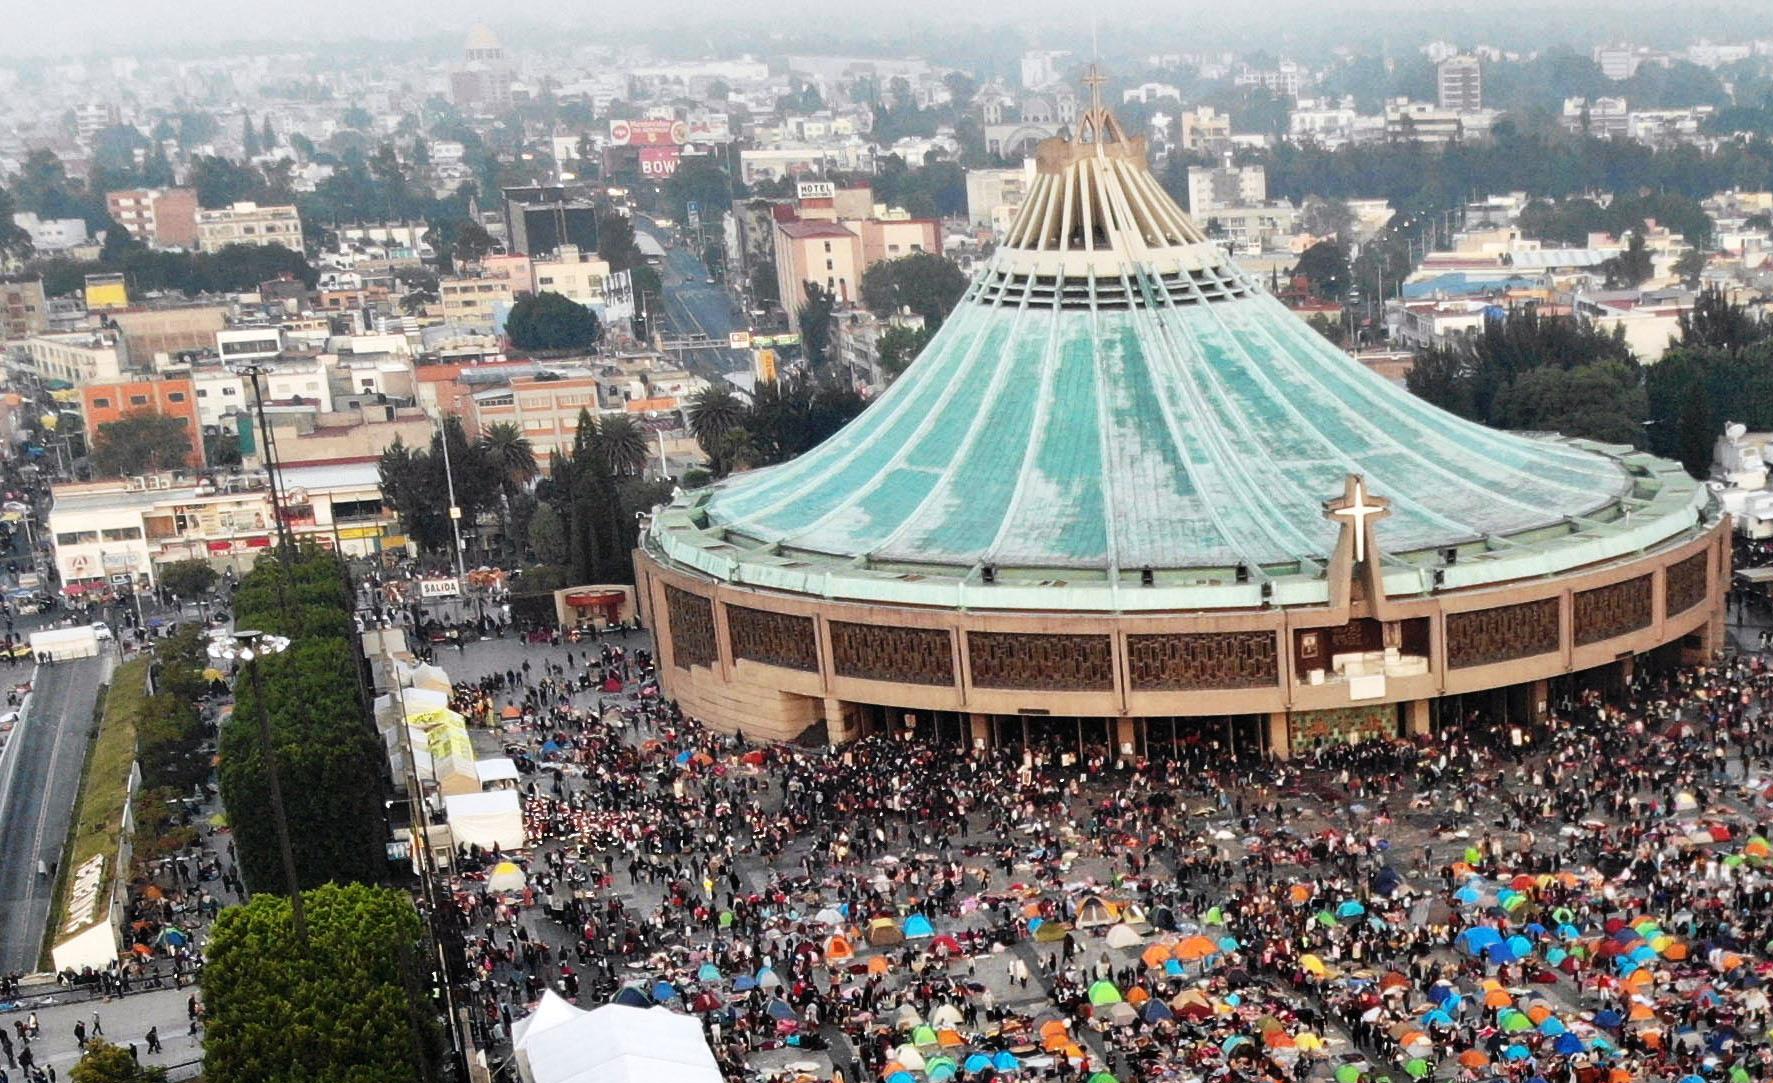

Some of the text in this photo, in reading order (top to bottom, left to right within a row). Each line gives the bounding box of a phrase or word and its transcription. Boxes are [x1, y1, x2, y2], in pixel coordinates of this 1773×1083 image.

[642, 160, 681, 174] BOW
[801, 184, 831, 193] HOTEL
[424, 582, 457, 593] SALIDA
